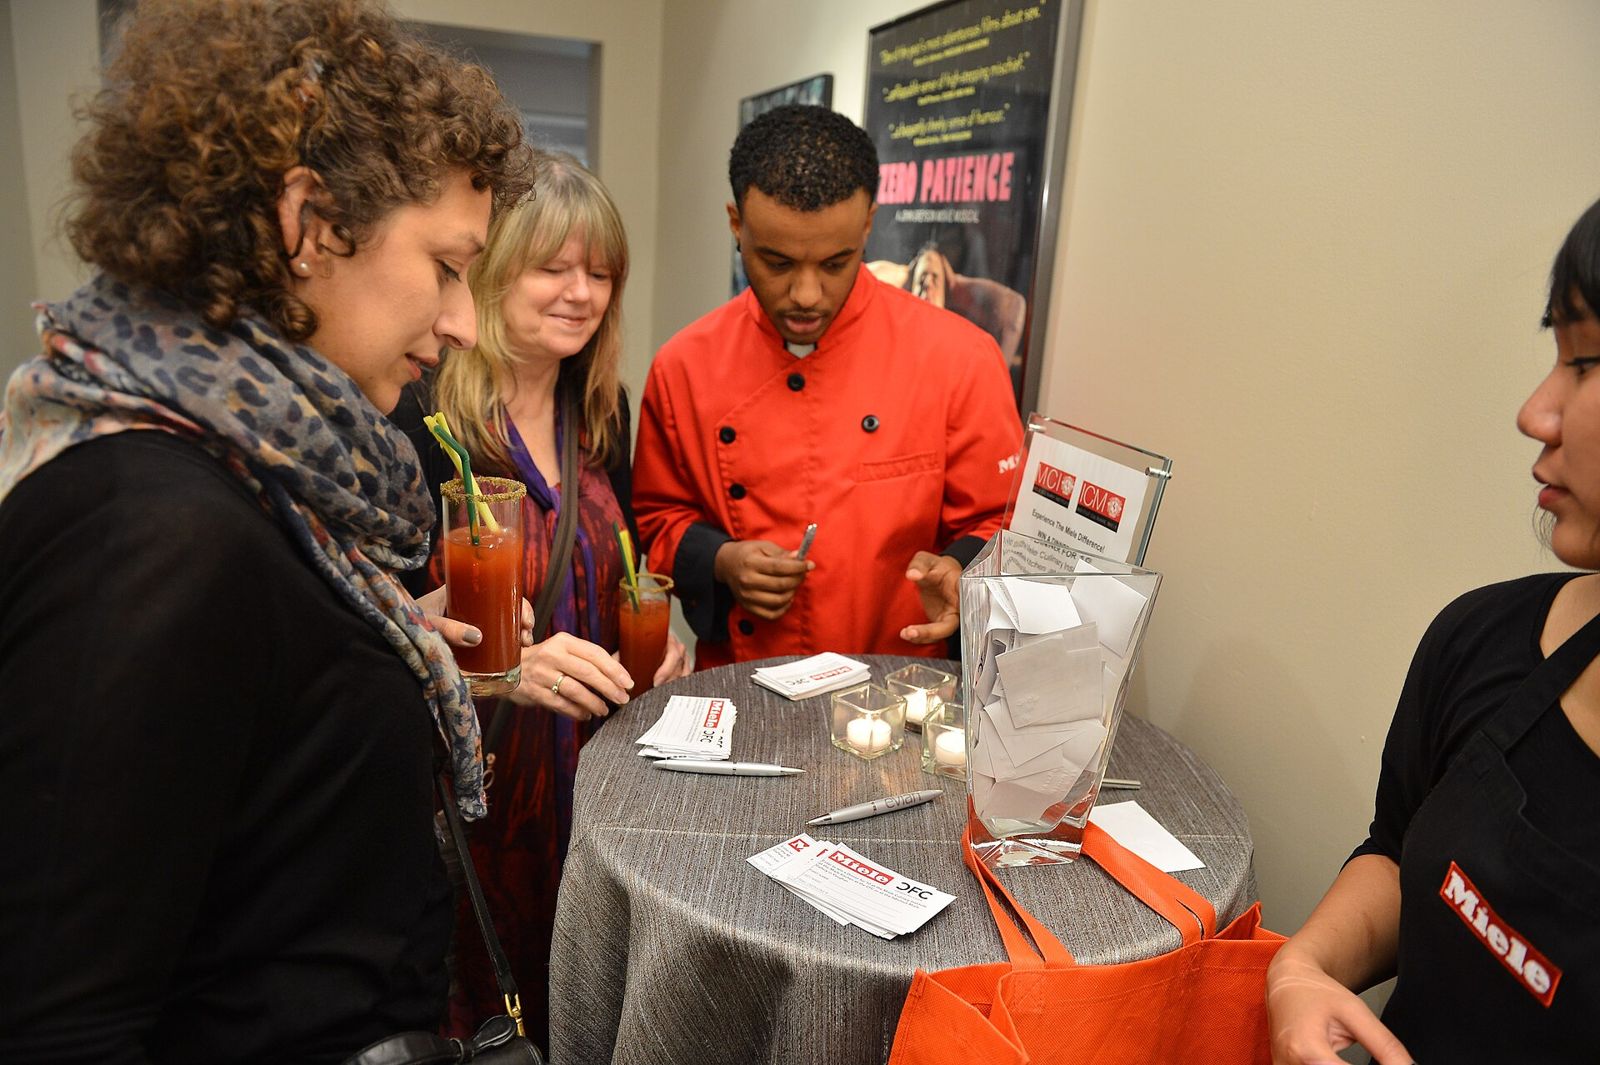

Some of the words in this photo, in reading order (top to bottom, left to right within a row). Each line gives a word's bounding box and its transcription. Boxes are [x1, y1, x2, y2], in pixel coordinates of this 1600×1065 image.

[877, 161, 918, 205] ZERO
[920, 152, 1015, 204] PATIENCE
[1037, 464, 1062, 492] MCI
[1080, 483, 1108, 512] ICM
[1032, 509, 1055, 527] Experience
[1055, 521, 1065, 531] The
[1065, 526, 1078, 539] Miele
[1077, 533, 1106, 553] Difference!
[705, 701, 723, 728] Miele
[884, 792, 921, 809] evian
[831, 853, 890, 884] Miele
[1444, 870, 1551, 994] Miele
